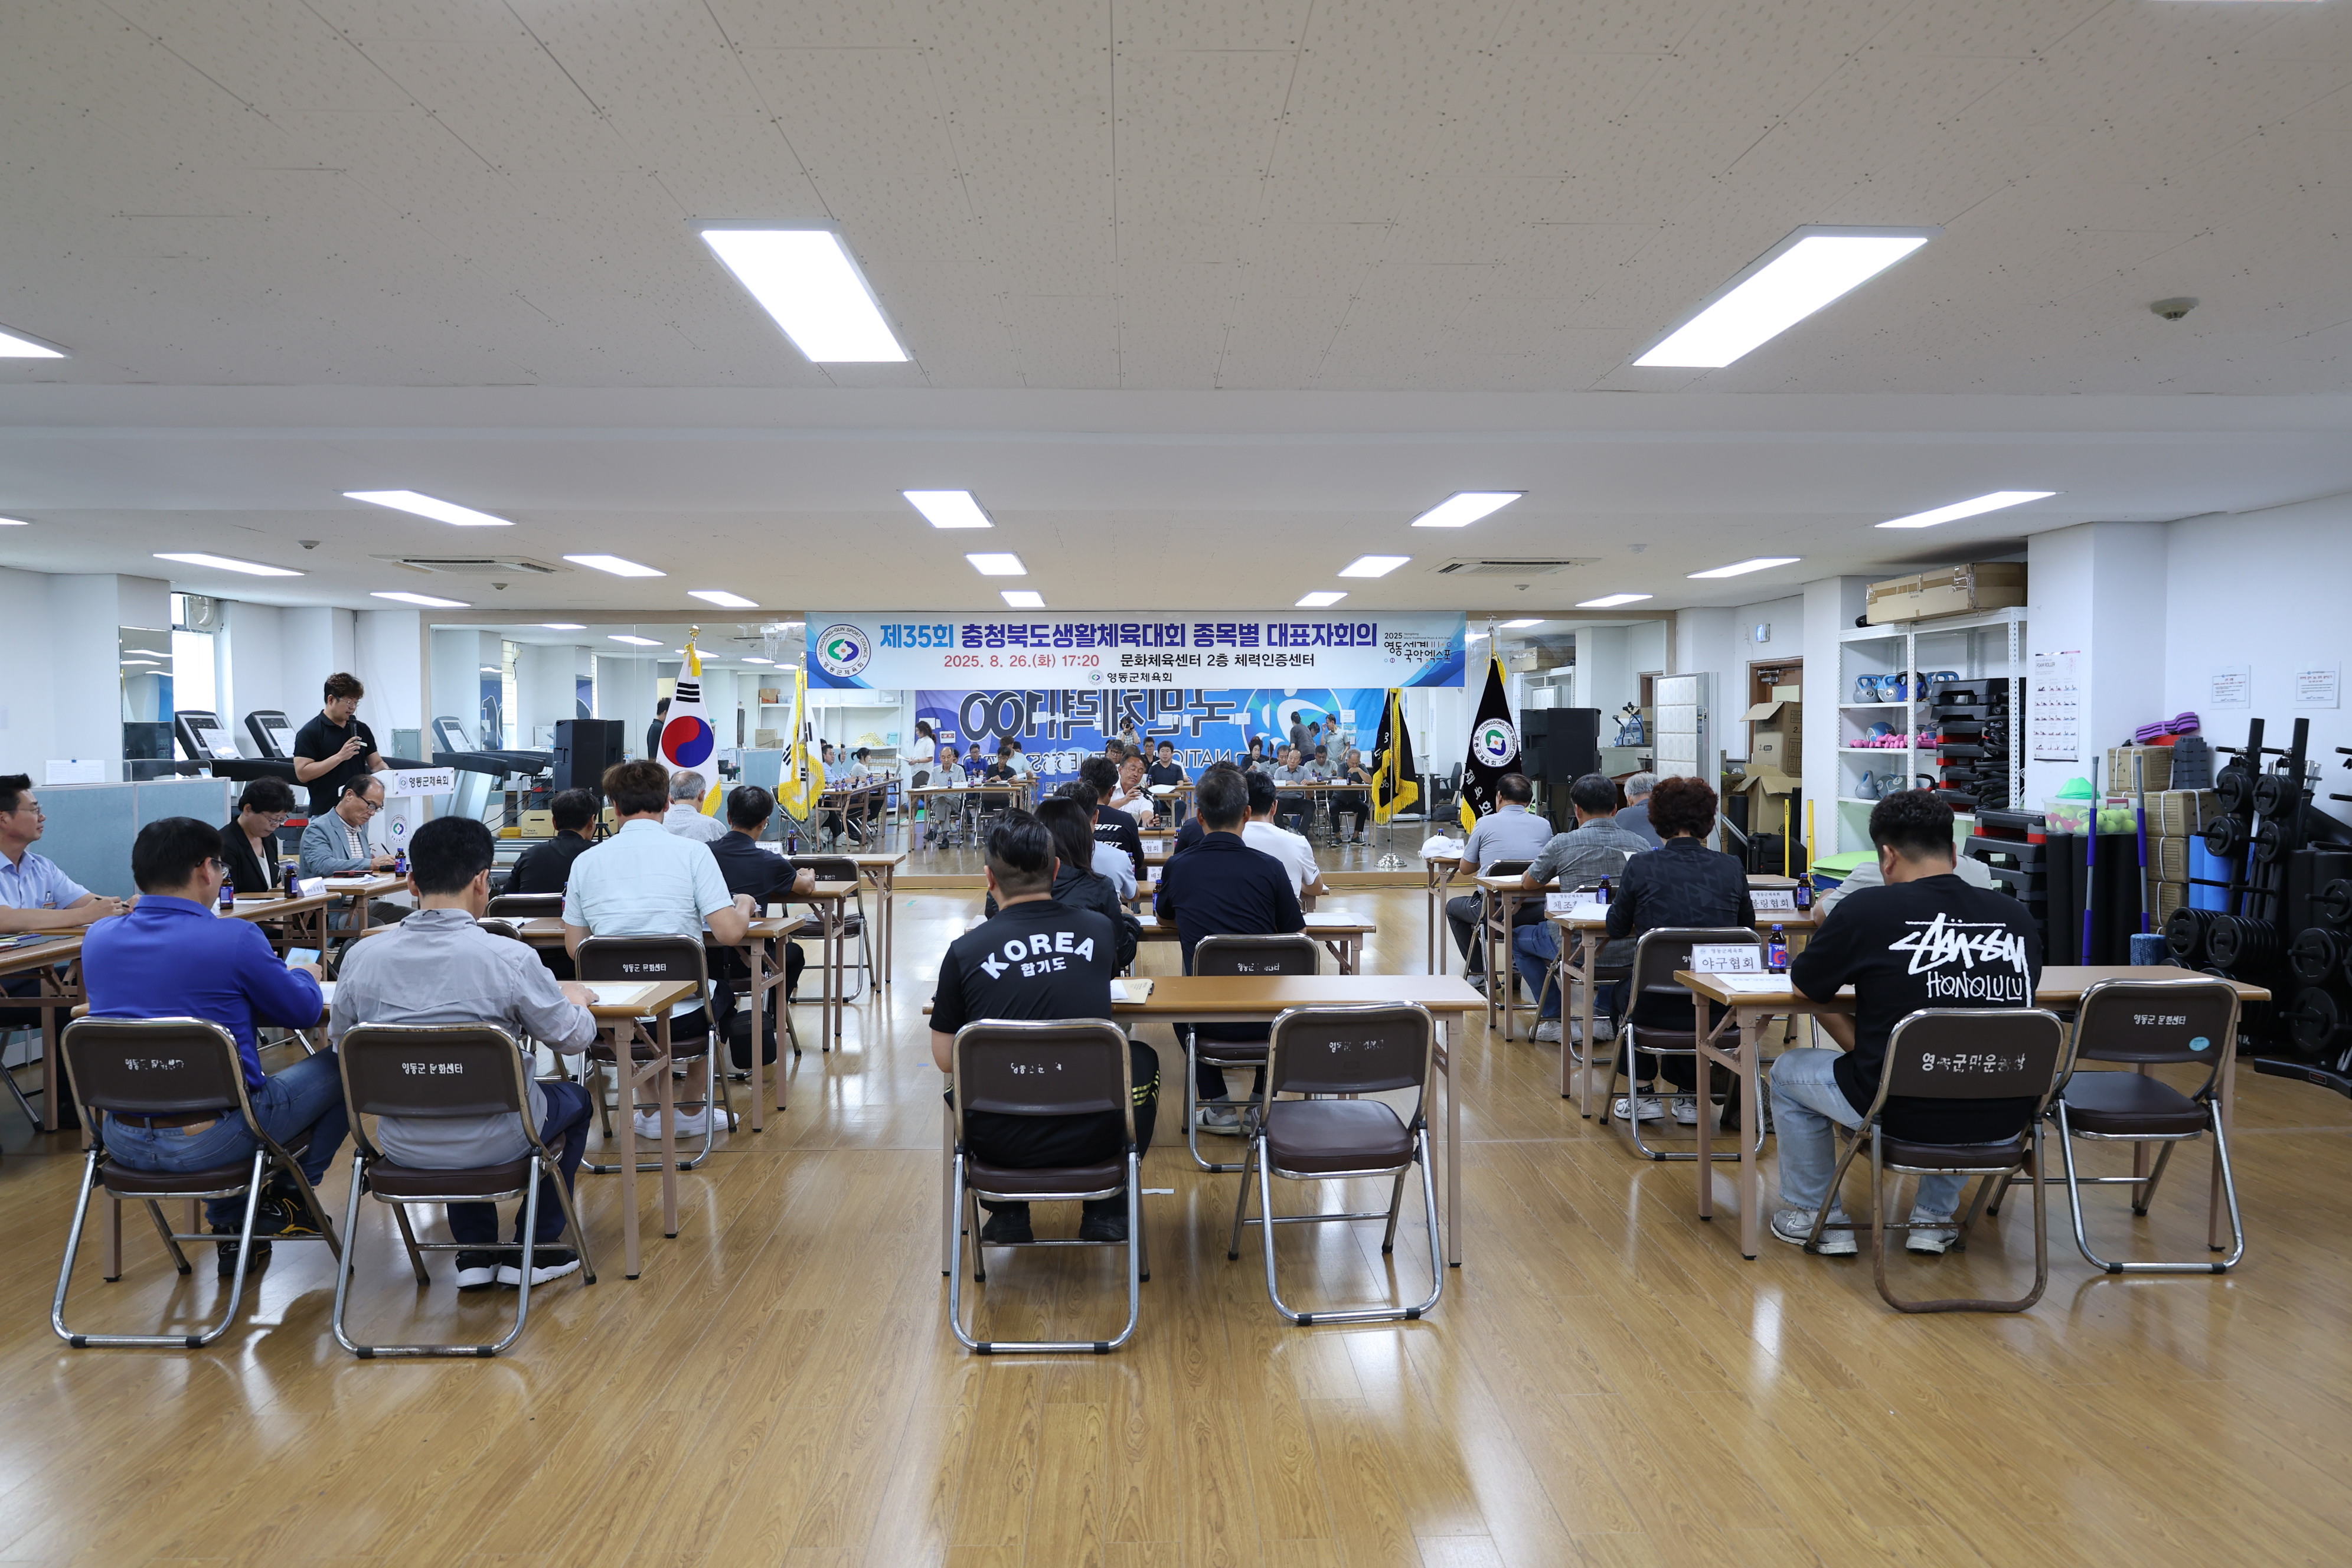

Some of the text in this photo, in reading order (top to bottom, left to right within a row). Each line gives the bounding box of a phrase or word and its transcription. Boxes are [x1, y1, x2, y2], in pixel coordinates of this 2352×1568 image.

[818, 627, 868, 658] YEONGDONG-GUN SPORT COUNCIL
[880, 623, 1377, 648] 제35회 충청북도생활체육대회 종목별 대표자회의
[944, 654, 1314, 668] 2025. 8. 26.(화) 17:20 문화체육센터 2층 체력인증센터
[1404, 649, 1451, 663] 국악엑스포
[1107, 672, 1172, 683] 영동군체육회
[1479, 720, 1513, 734] YEONGDONG-GUN
[1500, 750, 1515, 765] COUNCIL
[409, 776, 449, 788] 영동군체육회
[981, 932, 1094, 979] KOREA
[1702, 956, 1754, 969] 야구협회
[623, 963, 640, 972] 영동군
[1021, 956, 1067, 977] 합기도
[1926, 971, 2023, 1002] HONOLULU
[2134, 1014, 2155, 1025] 영동군
[402, 1063, 426, 1074] 영동군
